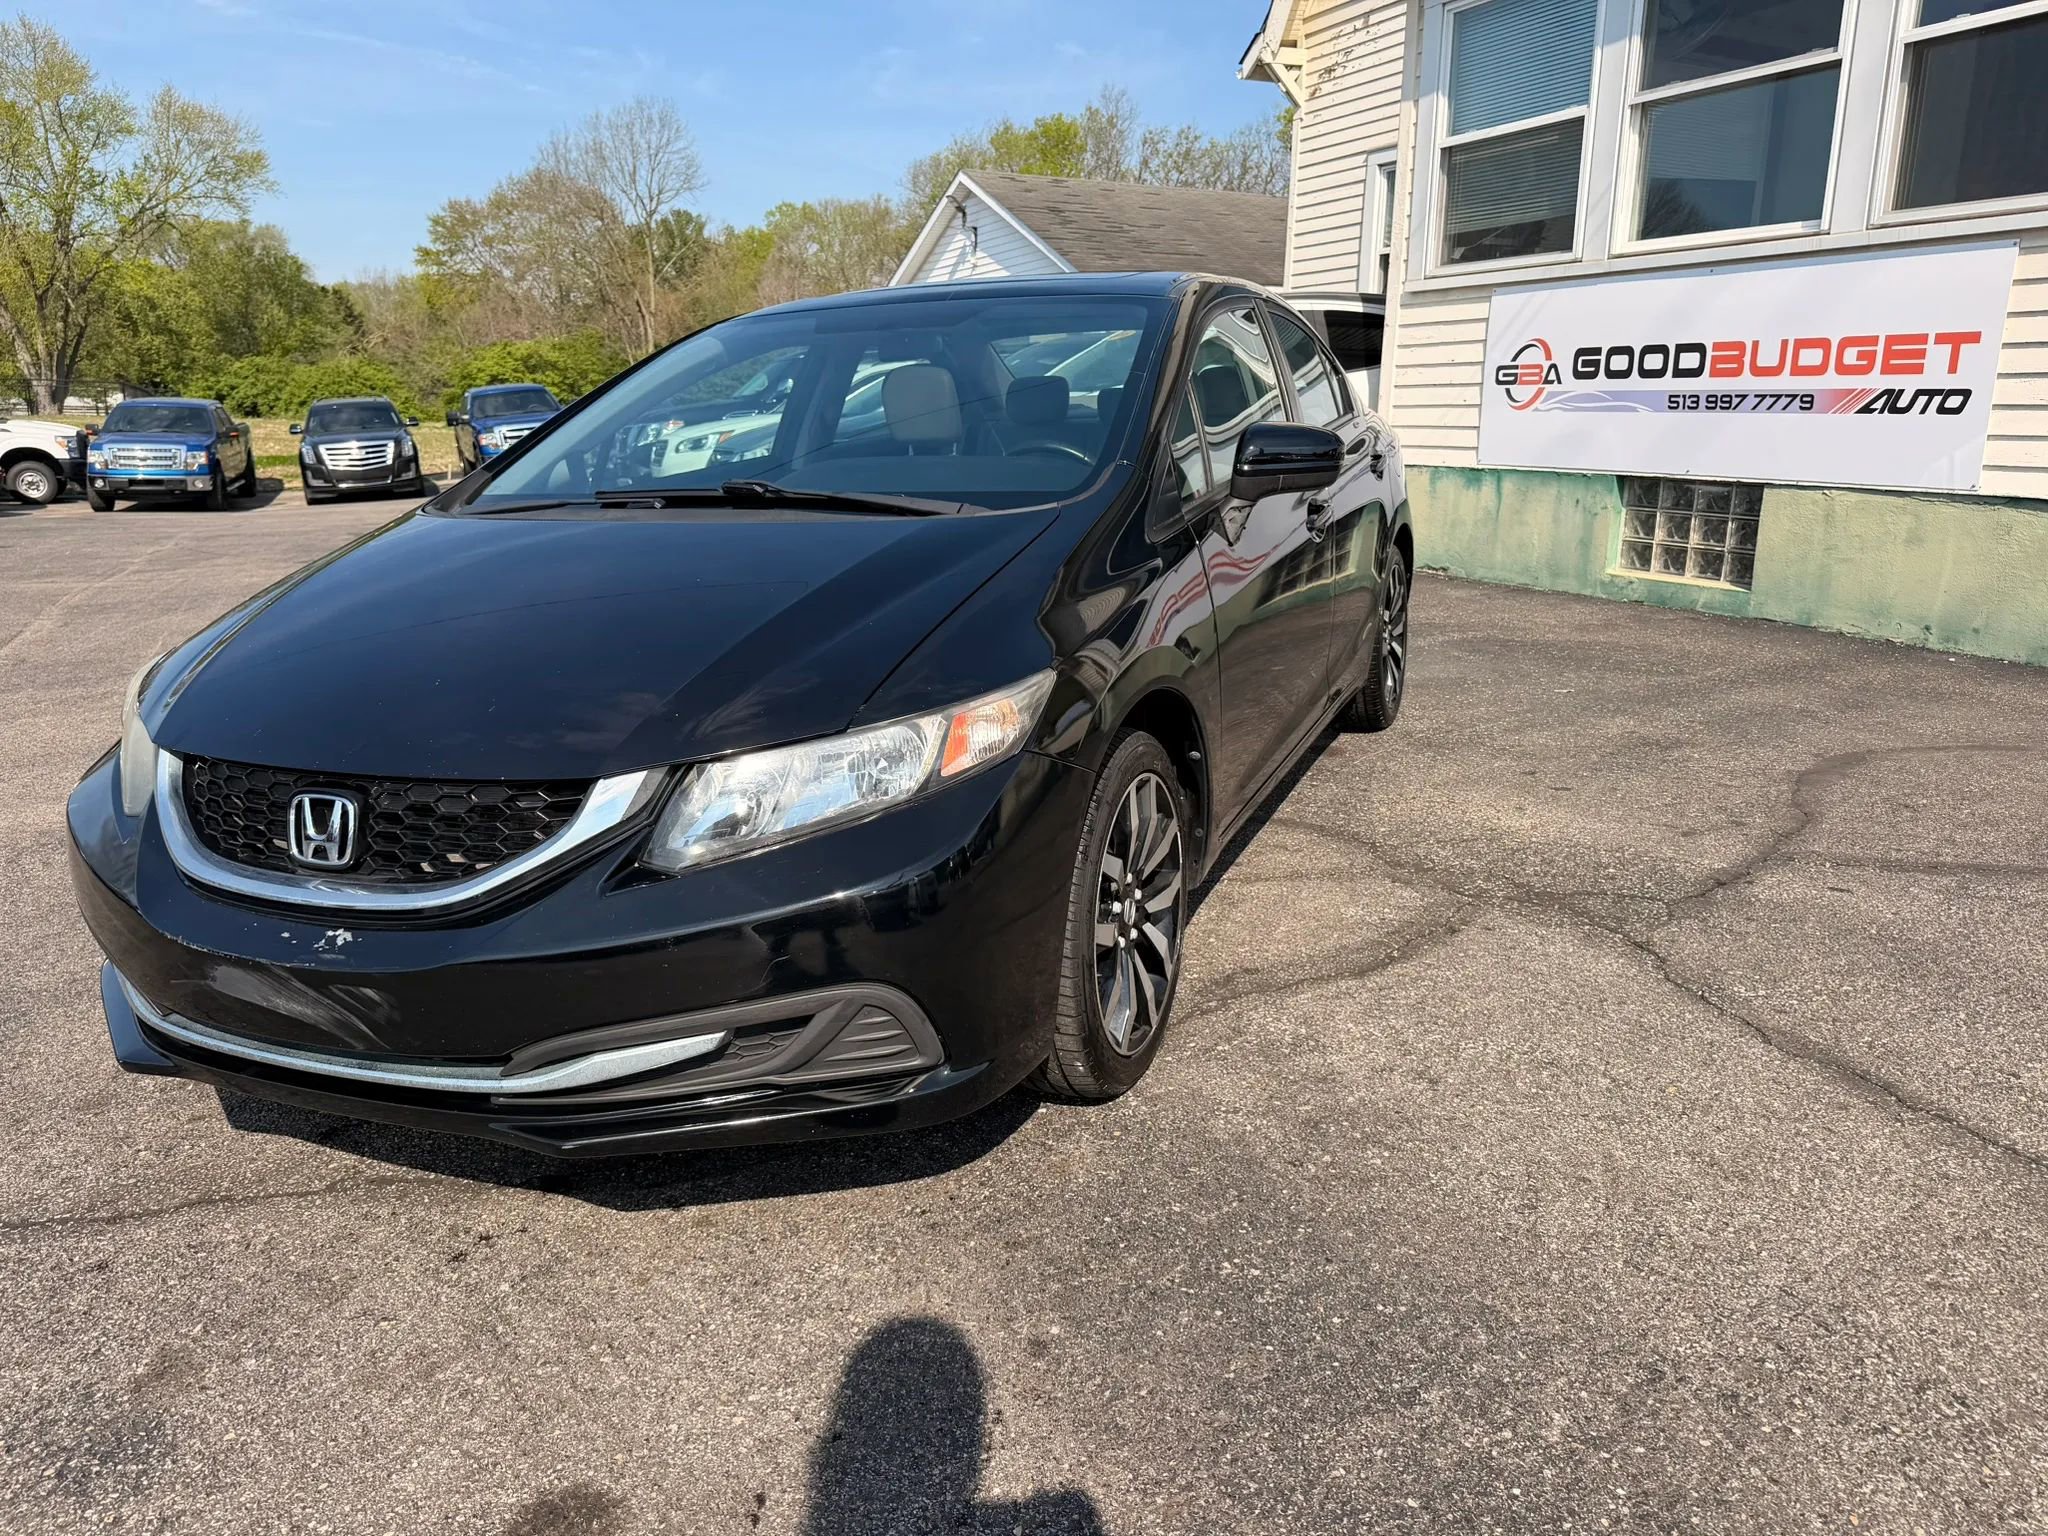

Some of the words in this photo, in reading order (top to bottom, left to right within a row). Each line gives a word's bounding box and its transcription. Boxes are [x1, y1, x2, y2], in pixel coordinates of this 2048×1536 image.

[1495, 363, 1562, 386] GBA
[1667, 394, 1699, 411] 513
[1704, 394, 1748, 411] 997
[1750, 393, 1815, 411] 7779
[1856, 388, 1973, 415] AUTO
